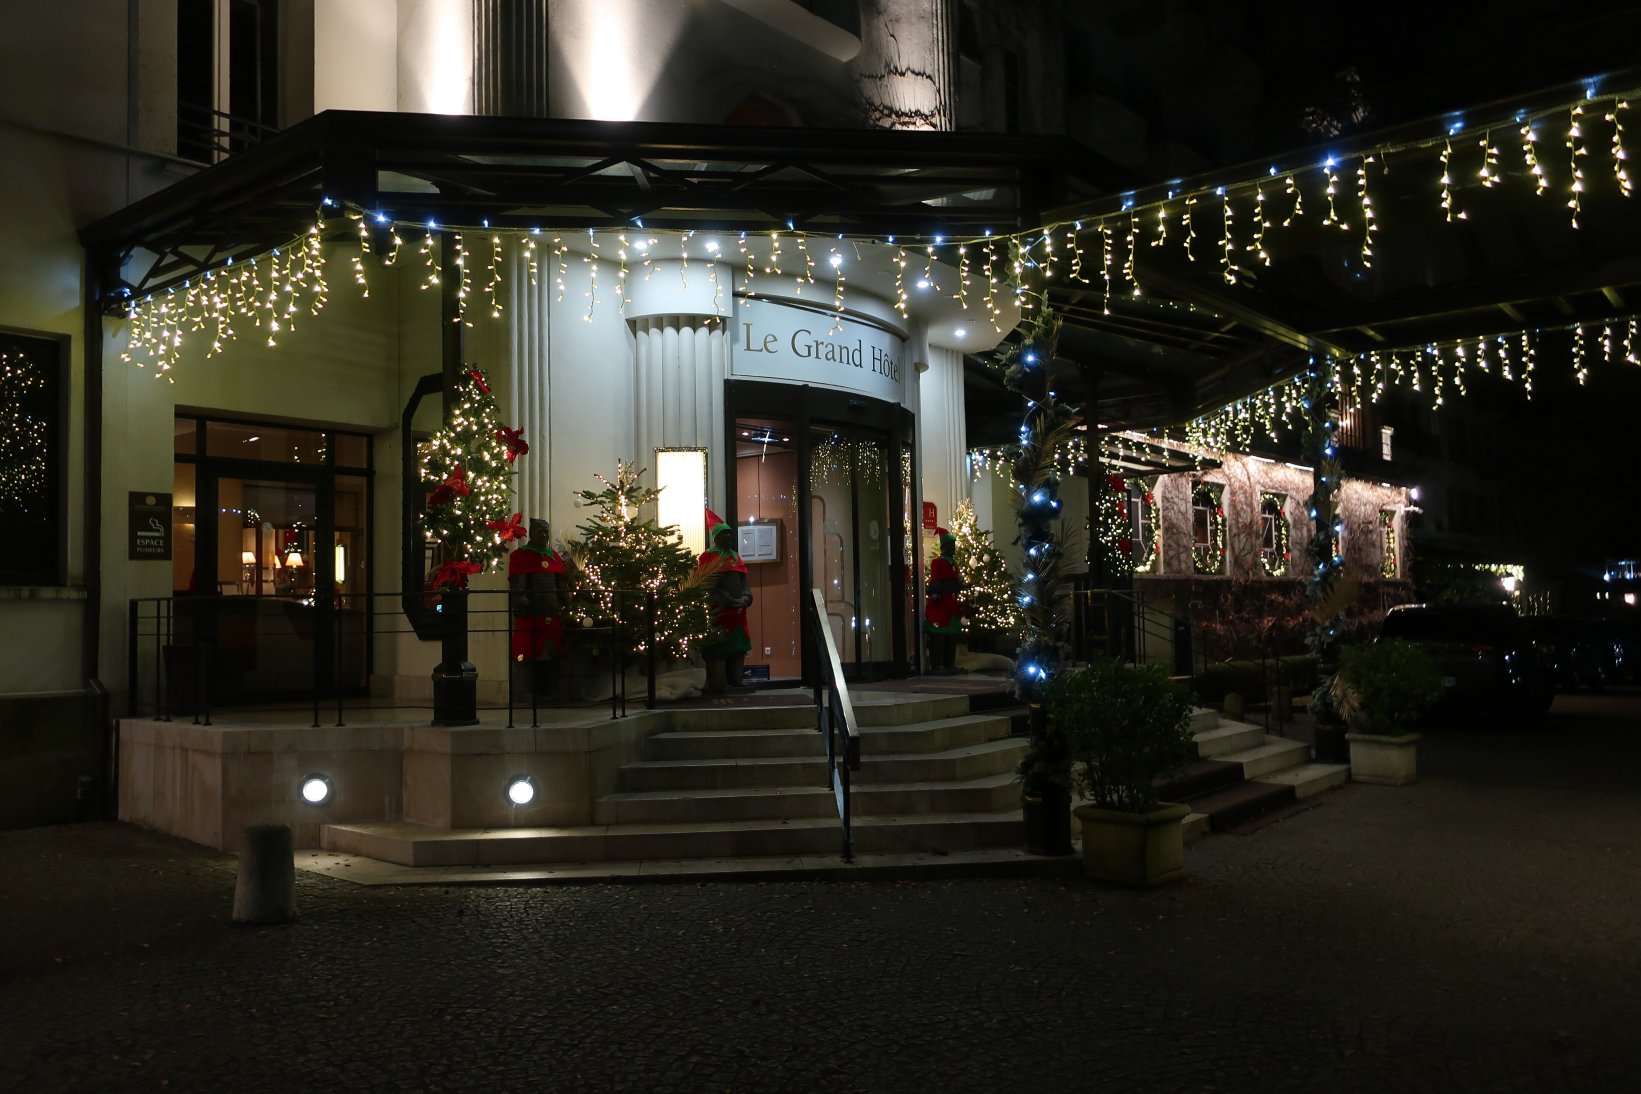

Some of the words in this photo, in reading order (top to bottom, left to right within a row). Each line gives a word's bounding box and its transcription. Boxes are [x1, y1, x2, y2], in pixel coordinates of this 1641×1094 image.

[743, 323, 778, 353] Le
[791, 329, 864, 368] Grand
[871, 345, 901, 384] Hôtel
[928, 507, 935, 518] H
[136, 538, 164, 546] ESPACE
